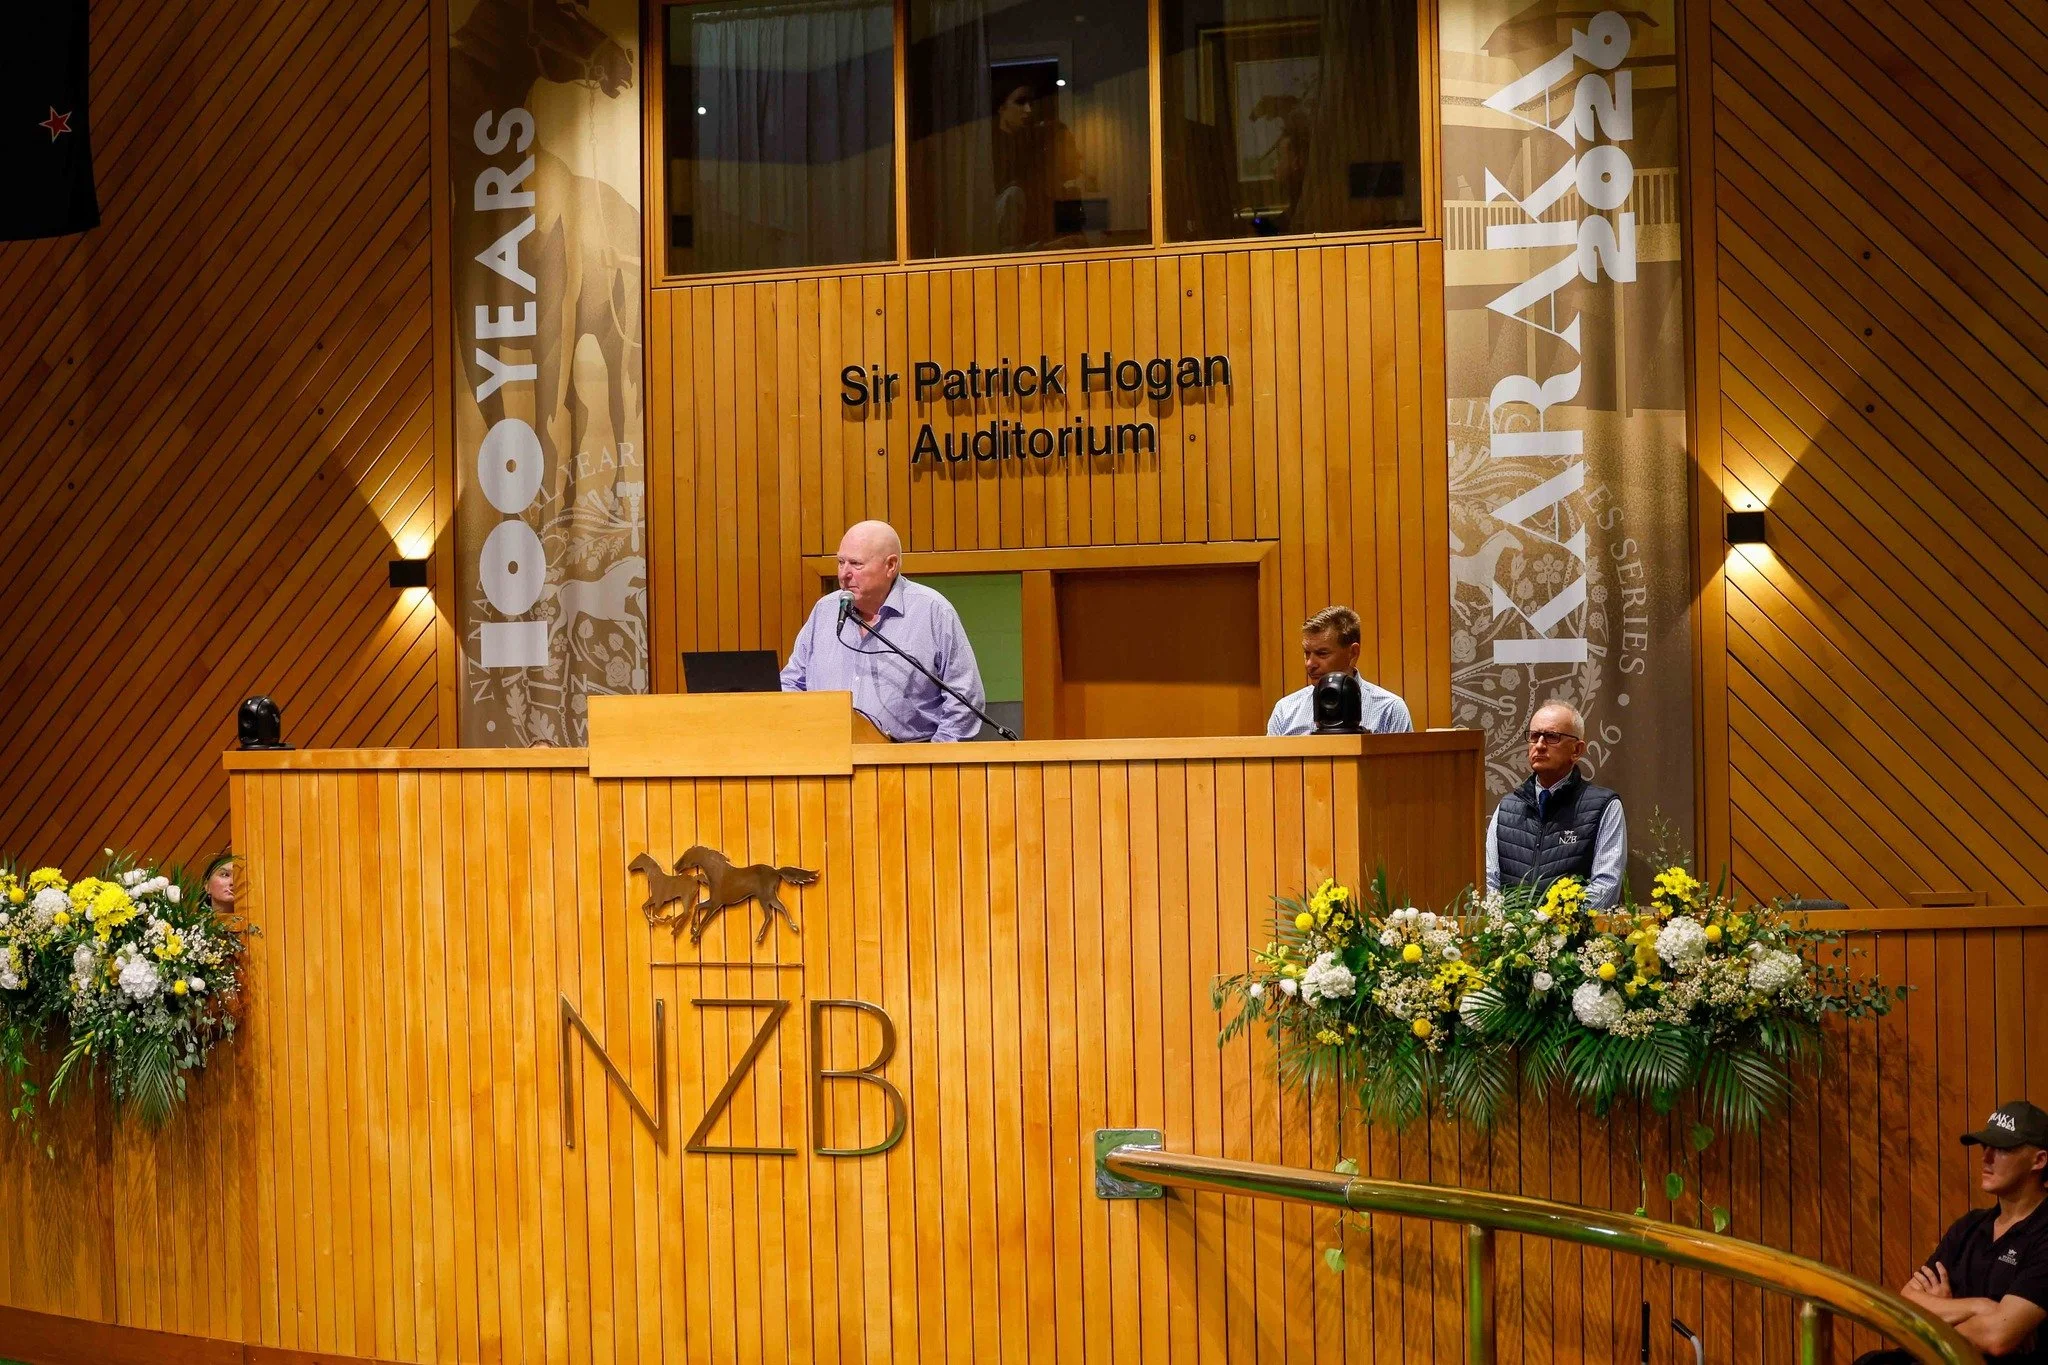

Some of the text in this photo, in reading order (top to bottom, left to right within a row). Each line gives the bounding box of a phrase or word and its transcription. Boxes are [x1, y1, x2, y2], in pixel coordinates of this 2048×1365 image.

[1572, 10, 1637, 283] 2026
[474, 106, 538, 403] YEARS
[840, 351, 1231, 405] Sir Patrick Hogan
[1482, 45, 1588, 665] KARAKA
[557, 442, 644, 487] YEAR
[911, 416, 1156, 464] Auditorium
[478, 418, 548, 669] 100
[1610, 537, 1649, 676] SERIES
[1572, 719, 1622, 782] 026
[1558, 835, 1578, 844] NZB
[560, 990, 908, 1158] NZB
